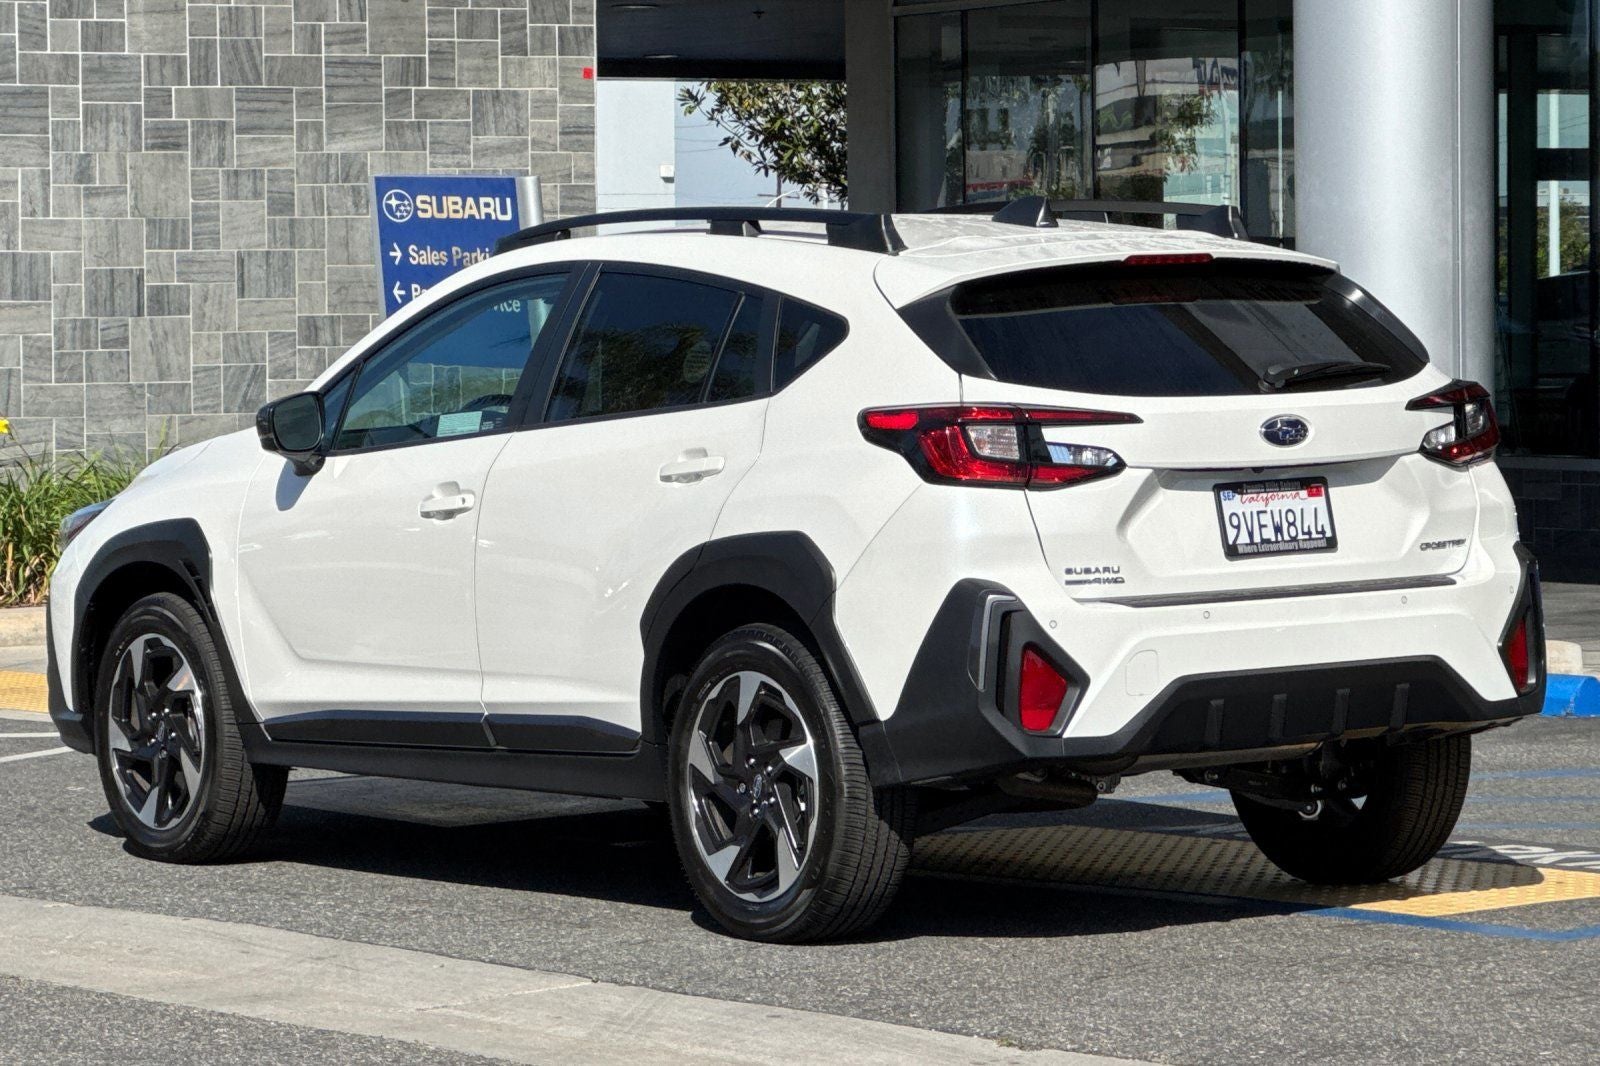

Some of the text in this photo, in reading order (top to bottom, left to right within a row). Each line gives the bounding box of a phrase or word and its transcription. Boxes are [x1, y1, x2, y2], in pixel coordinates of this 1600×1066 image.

[416, 195, 512, 221] SUBARU
[409, 245, 490, 267] Sales Parki
[1241, 491, 1307, 507] California
[1229, 507, 1327, 545] 9VEW844
[1065, 566, 1120, 575] SUBARU
